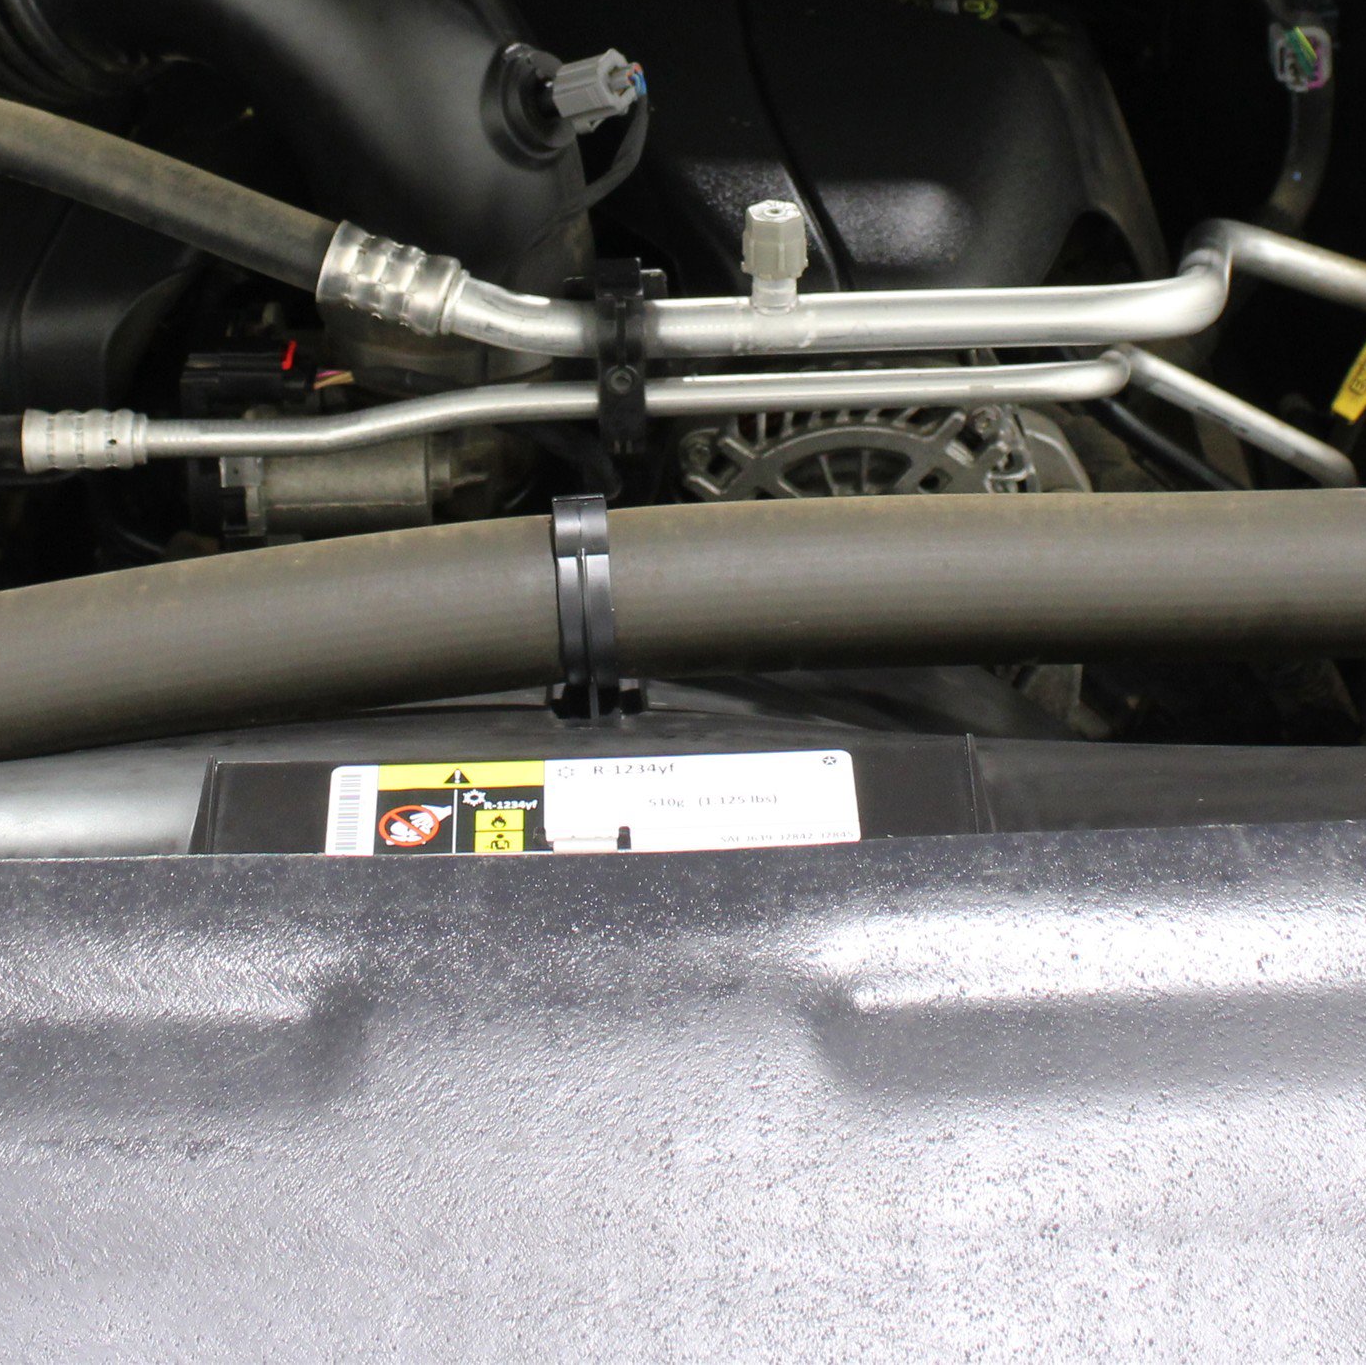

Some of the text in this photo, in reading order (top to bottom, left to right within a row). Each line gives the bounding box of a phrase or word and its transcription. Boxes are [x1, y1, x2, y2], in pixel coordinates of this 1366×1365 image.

[593, 762, 675, 775] R-1234yf
[483, 798, 539, 811] R-1234yf
[750, 794, 778, 805] lbs)
